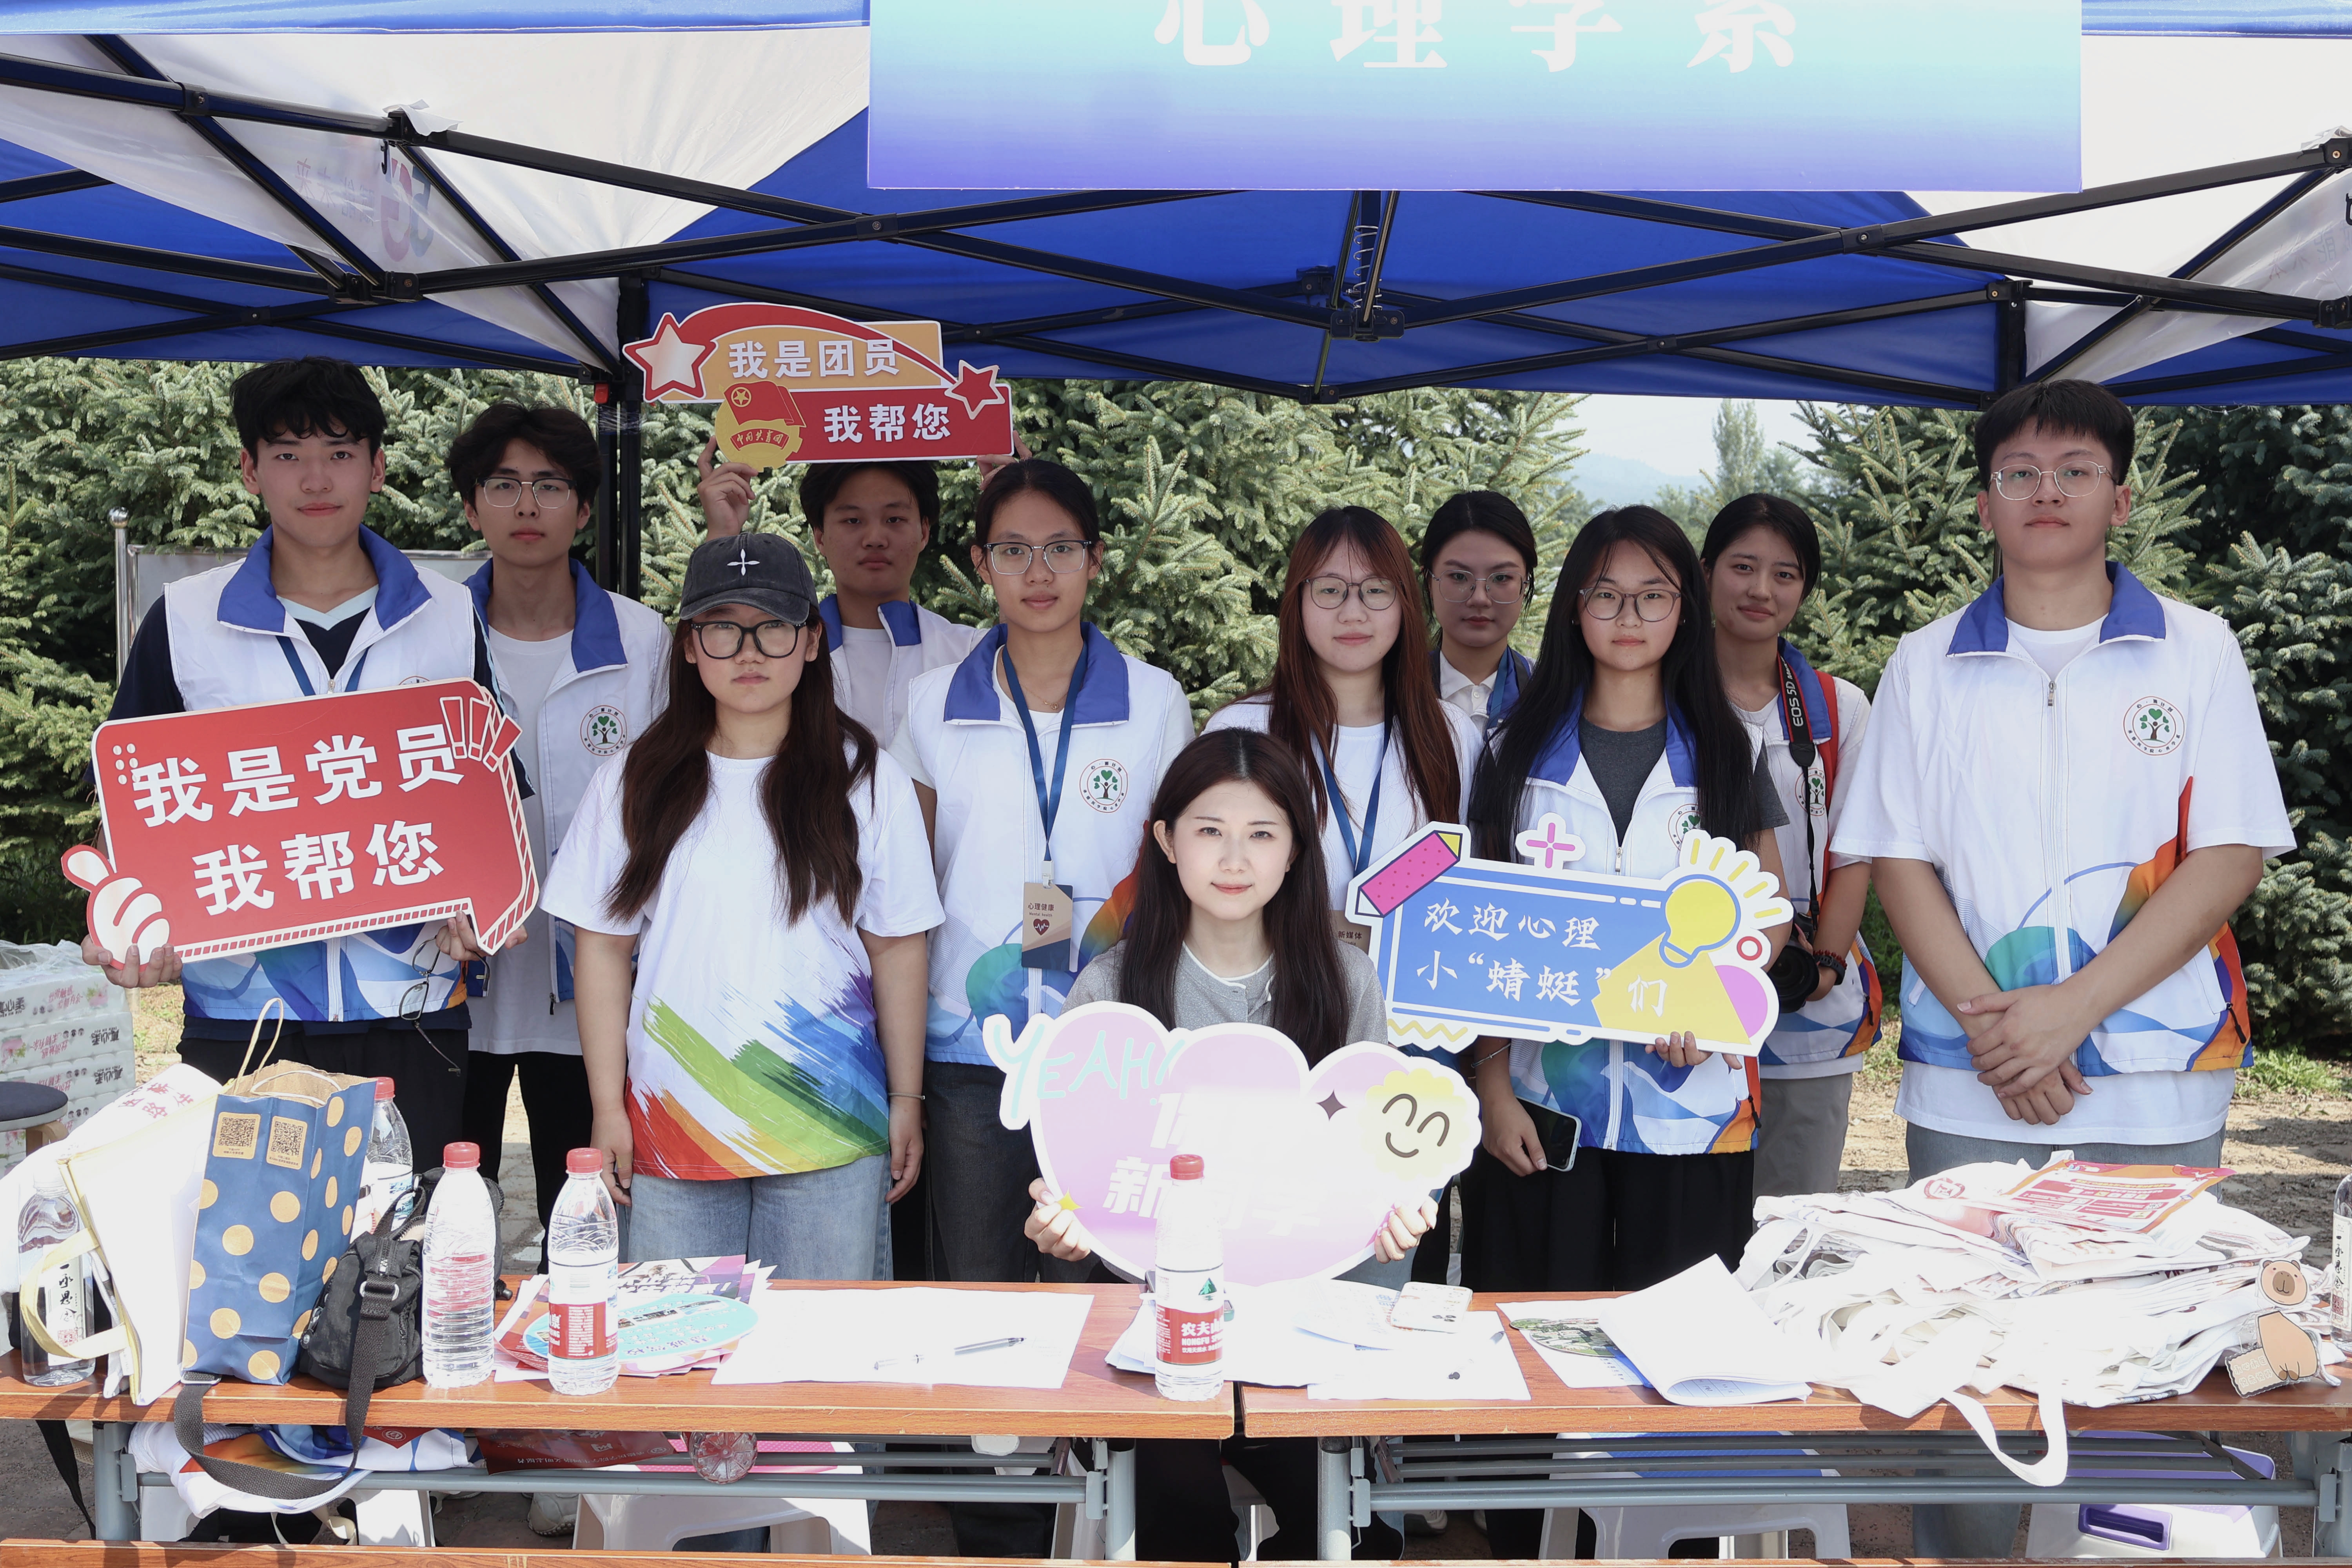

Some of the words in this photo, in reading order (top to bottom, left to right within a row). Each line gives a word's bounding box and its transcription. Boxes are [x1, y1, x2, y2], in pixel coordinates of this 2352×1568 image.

[728, 339, 900, 378] 我是团员
[823, 403, 951, 443] 我帮您
[737, 430, 784, 445] 中国共青团
[1786, 681, 1797, 695] 5D
[1789, 697, 1804, 726] EOS
[131, 724, 465, 828] 我是党员
[192, 820, 445, 916] 我帮您
[1028, 903, 1054, 911] 心理健康
[1423, 897, 1600, 951] 欢迎心理
[1338, 931, 1362, 940] 新媒体
[91, 1028, 120, 1046] 真心柔
[94, 1067, 123, 1085] 真心柔
[993, 1024, 1185, 1120] YEAH!
[1181, 1315, 1223, 1336] 农夫山
[1182, 1337, 1209, 1346] NONGFU
